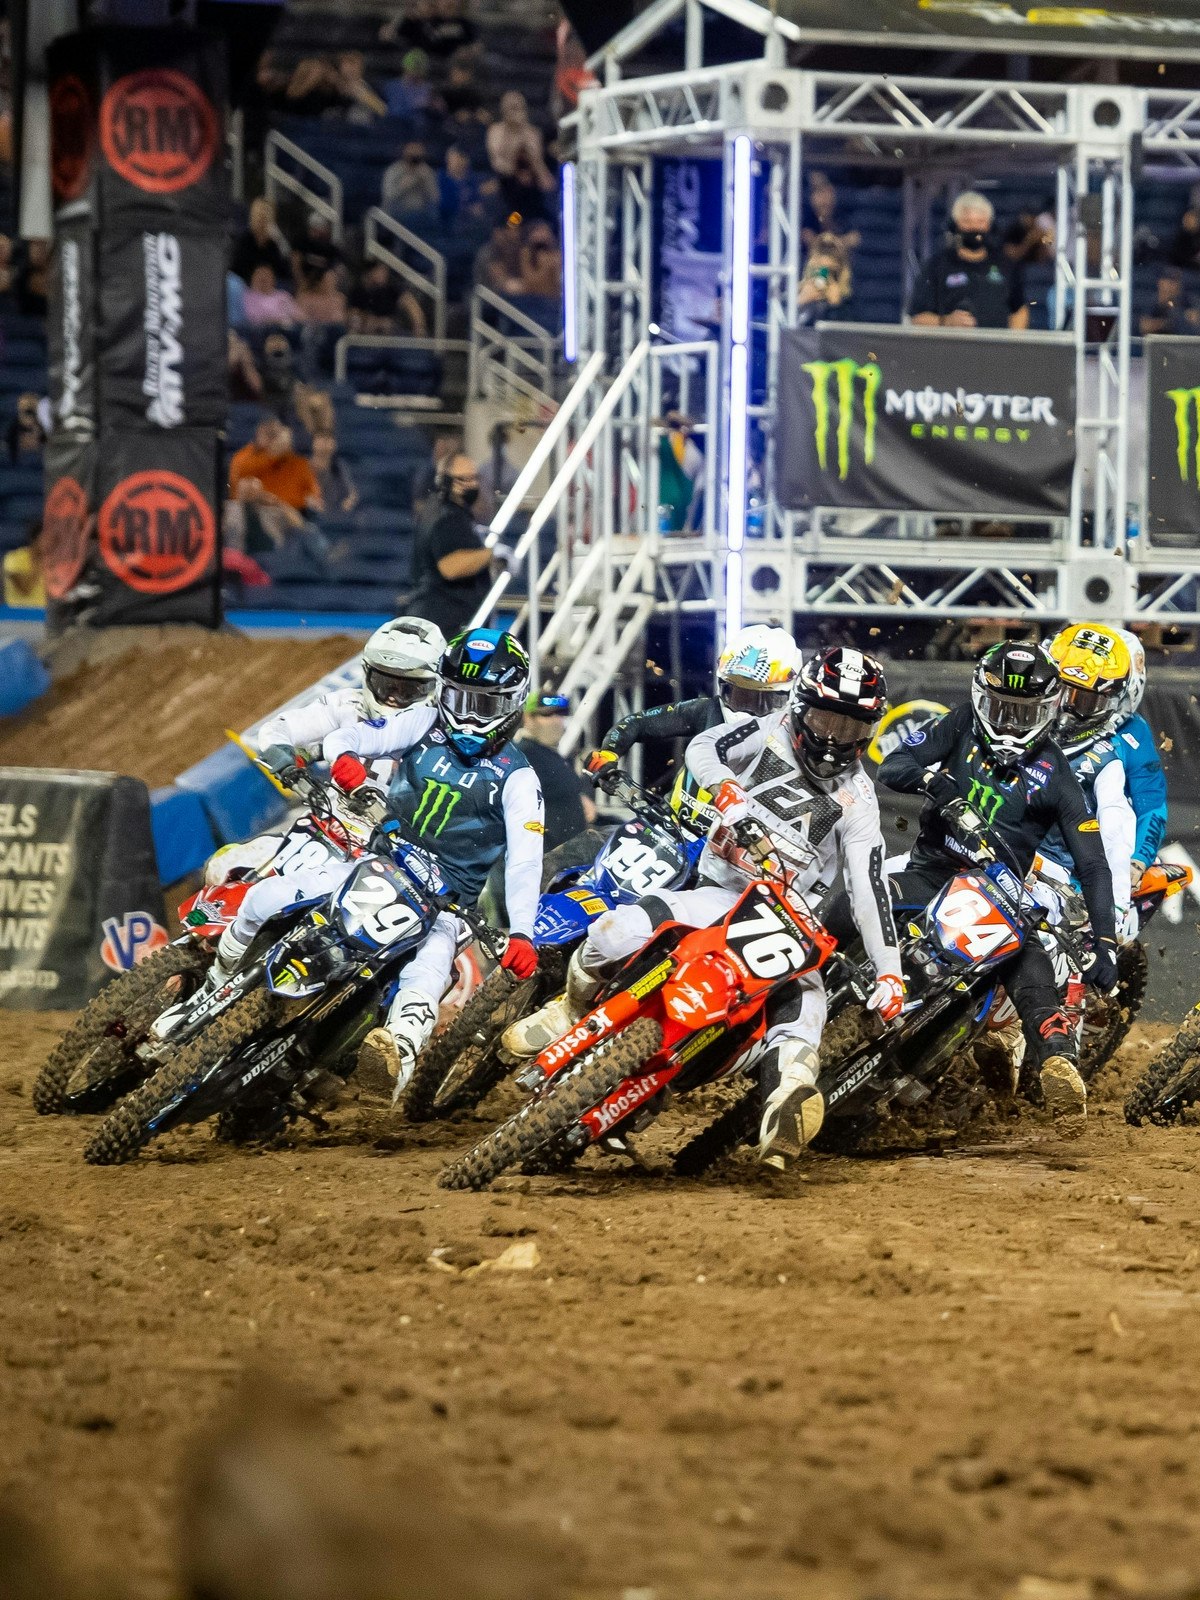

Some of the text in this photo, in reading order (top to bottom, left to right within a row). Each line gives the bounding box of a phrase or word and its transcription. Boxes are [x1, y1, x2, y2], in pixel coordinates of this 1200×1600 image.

[885, 386, 1057, 427] MONSTER
[910, 422, 1030, 444] ENERGY
[471, 641, 490, 649] BELL
[842, 664, 863, 676] Arai
[600, 836, 677, 898] 193
[340, 875, 423, 946] 29
[935, 888, 1019, 959] 64
[103, 914, 153, 970] VP
[723, 947, 751, 978] HONDA
[725, 902, 806, 979] 76
[241, 1033, 297, 1087] DUNLOP
[828, 1052, 883, 1105] DUNLOP
